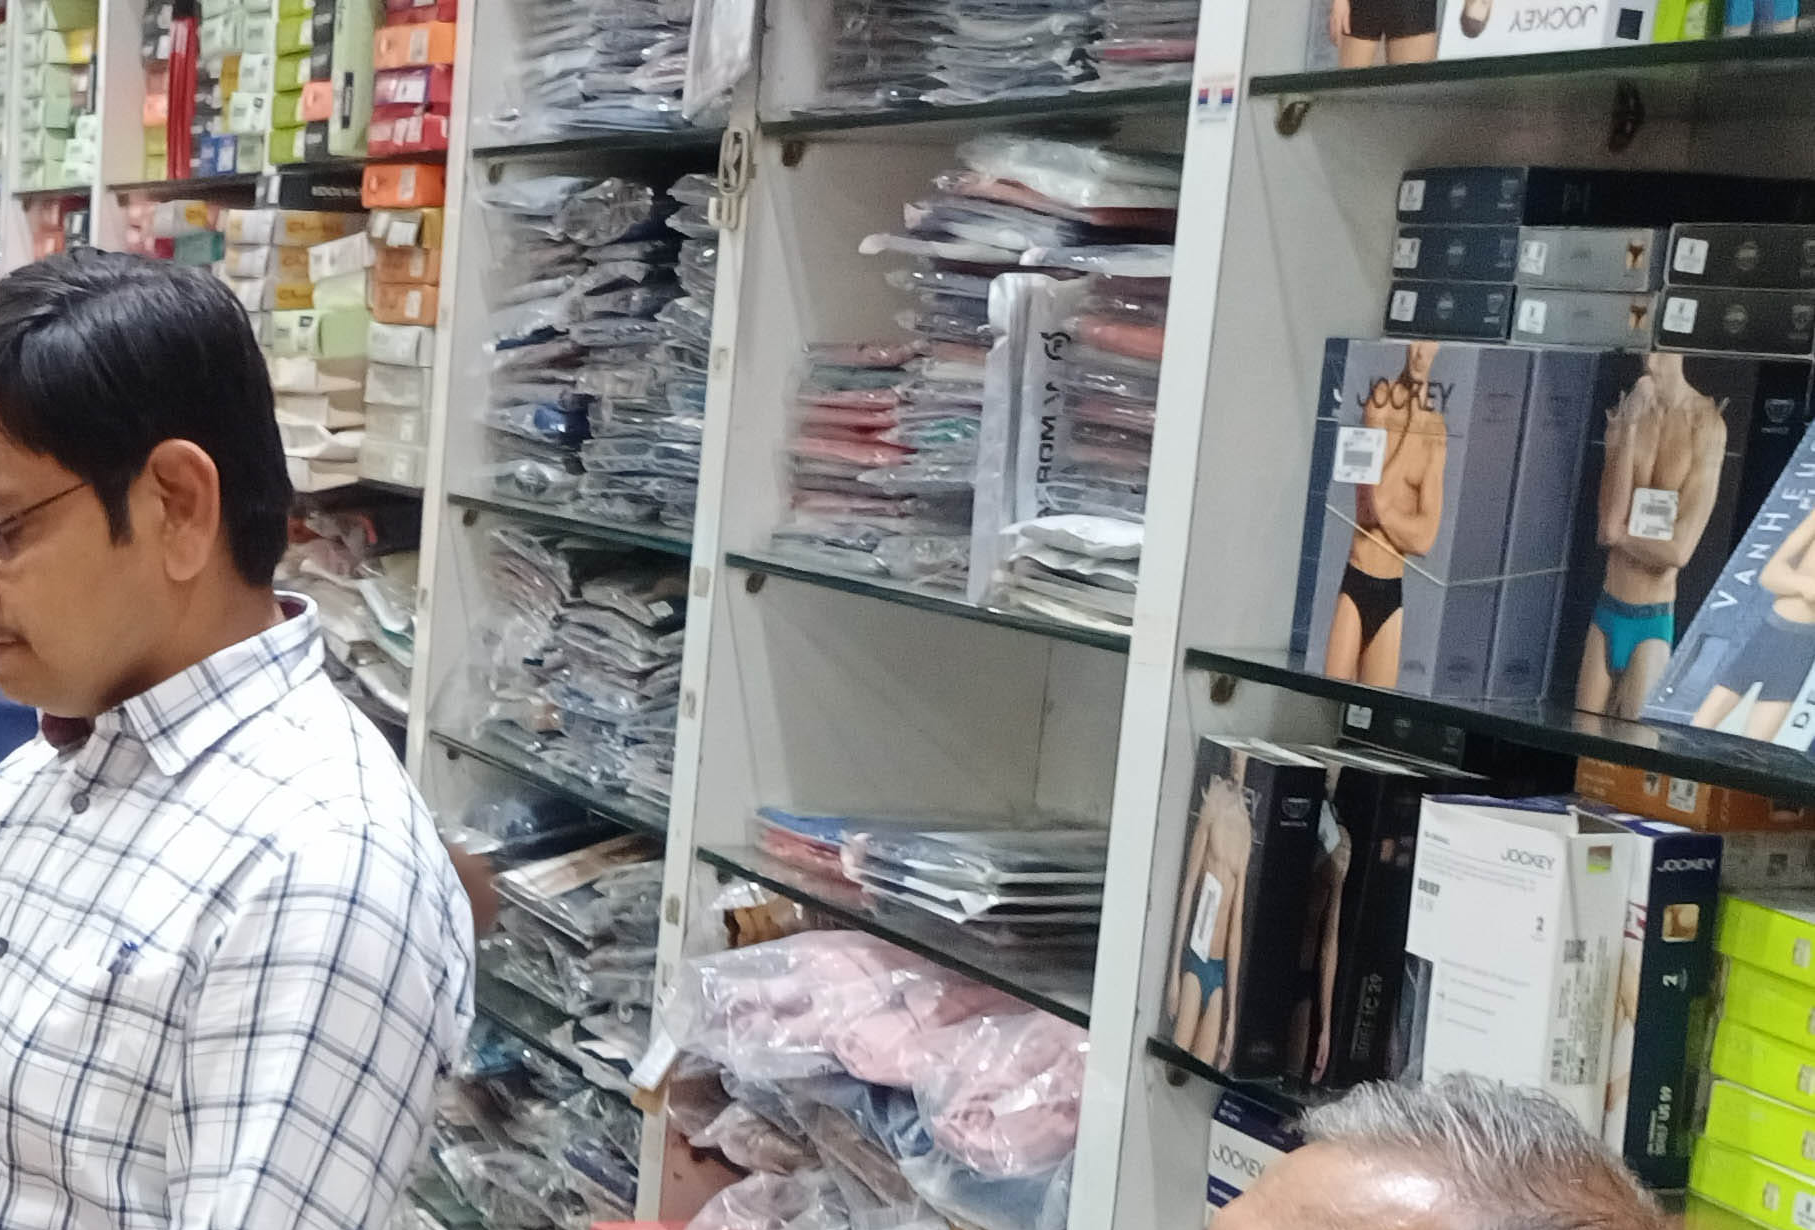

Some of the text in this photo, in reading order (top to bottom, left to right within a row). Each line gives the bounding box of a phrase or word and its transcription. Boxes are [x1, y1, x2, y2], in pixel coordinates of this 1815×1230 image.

[1509, 4, 1598, 33] JOCKEY
[1500, 848, 1555, 870] JOCKEY
[1656, 857, 1716, 873] JOCKEY
[1212, 1143, 1266, 1178] JOCKEY
